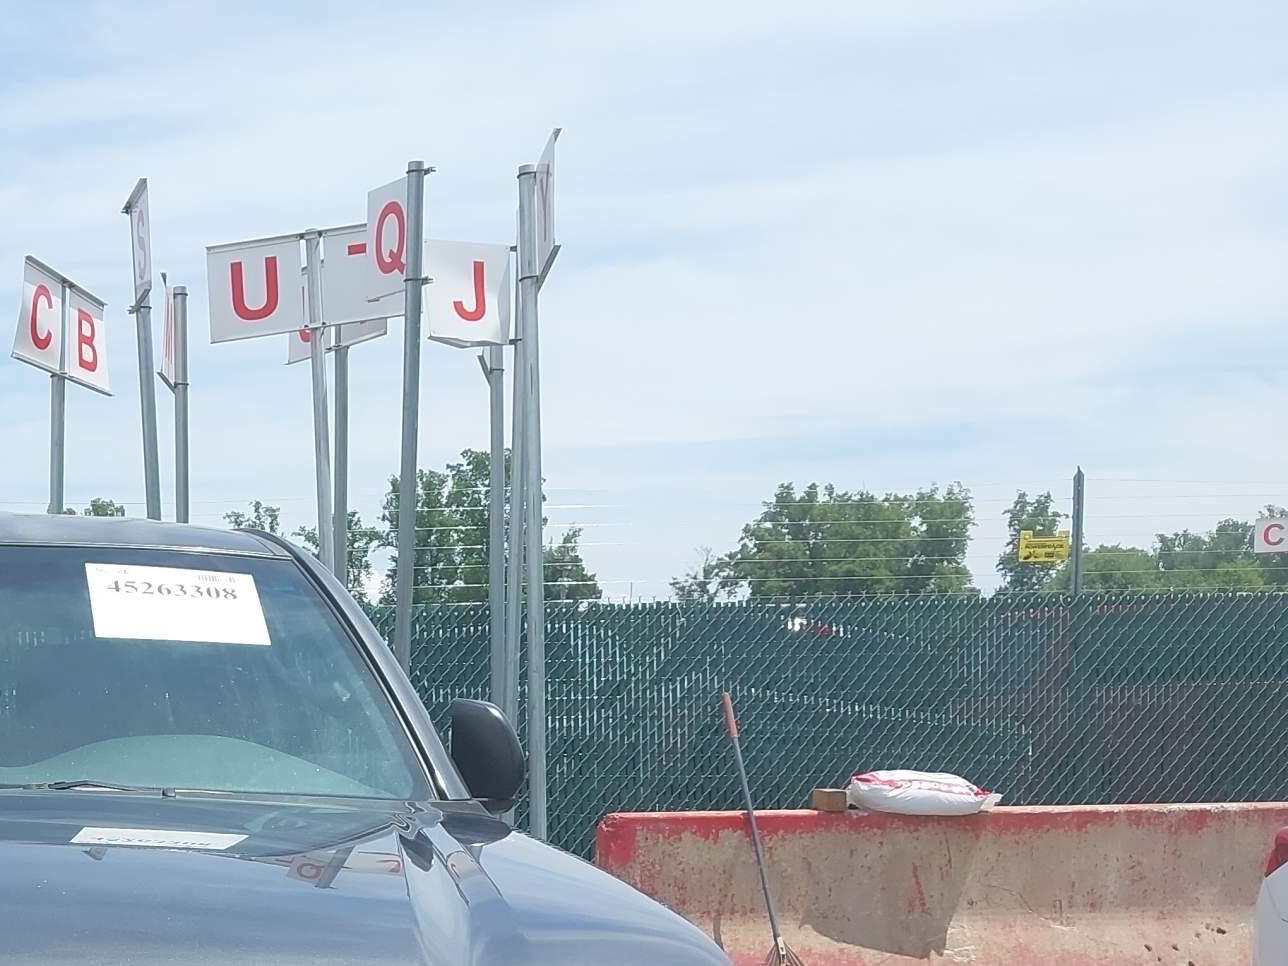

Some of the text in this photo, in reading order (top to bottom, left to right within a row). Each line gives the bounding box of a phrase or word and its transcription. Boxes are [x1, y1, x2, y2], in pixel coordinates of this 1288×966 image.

[136, 207, 147, 281] S
[29, 283, 53, 351] C
[229, 256, 280, 321] U
[453, 260, 487, 322] J
[76, 307, 98, 373] B
[1263, 523, 1286, 546] C
[107, 579, 238, 601] 45263308
